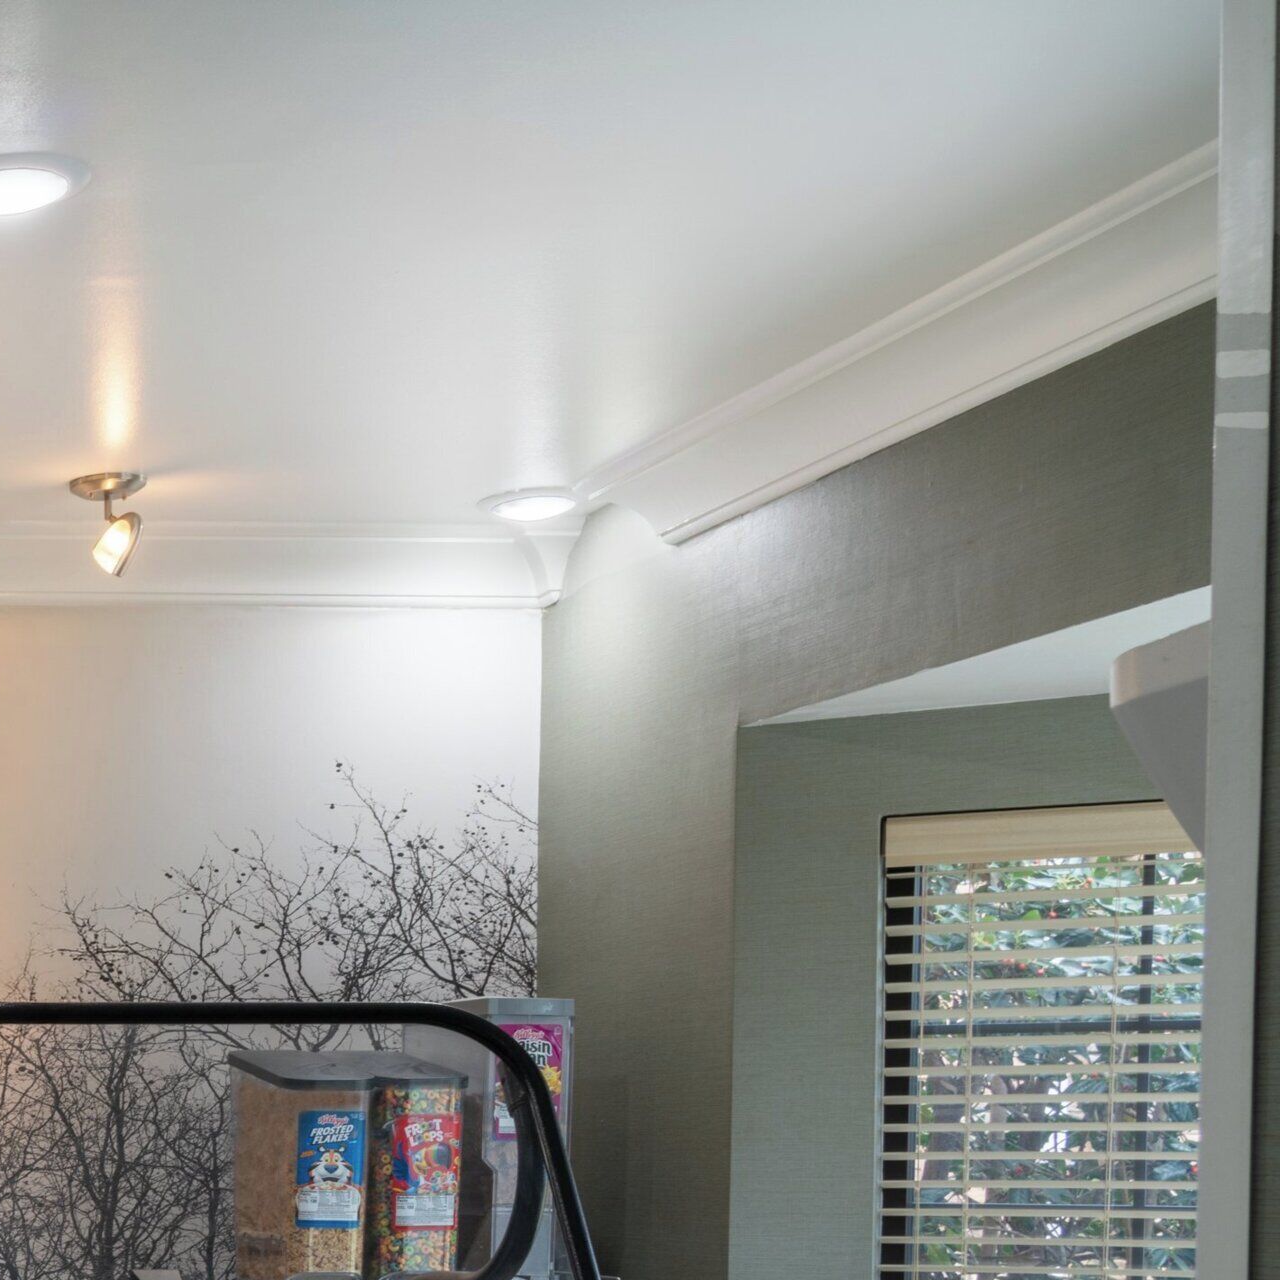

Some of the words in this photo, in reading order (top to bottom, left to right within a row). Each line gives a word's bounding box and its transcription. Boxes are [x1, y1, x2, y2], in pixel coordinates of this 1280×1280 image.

[520, 1040, 552, 1055] aisin
[310, 1124, 354, 1138] FROSTED
[404, 1118, 443, 1139] FROOT
[312, 1133, 350, 1145] FLAKES
[408, 1130, 444, 1147] LOOPS
